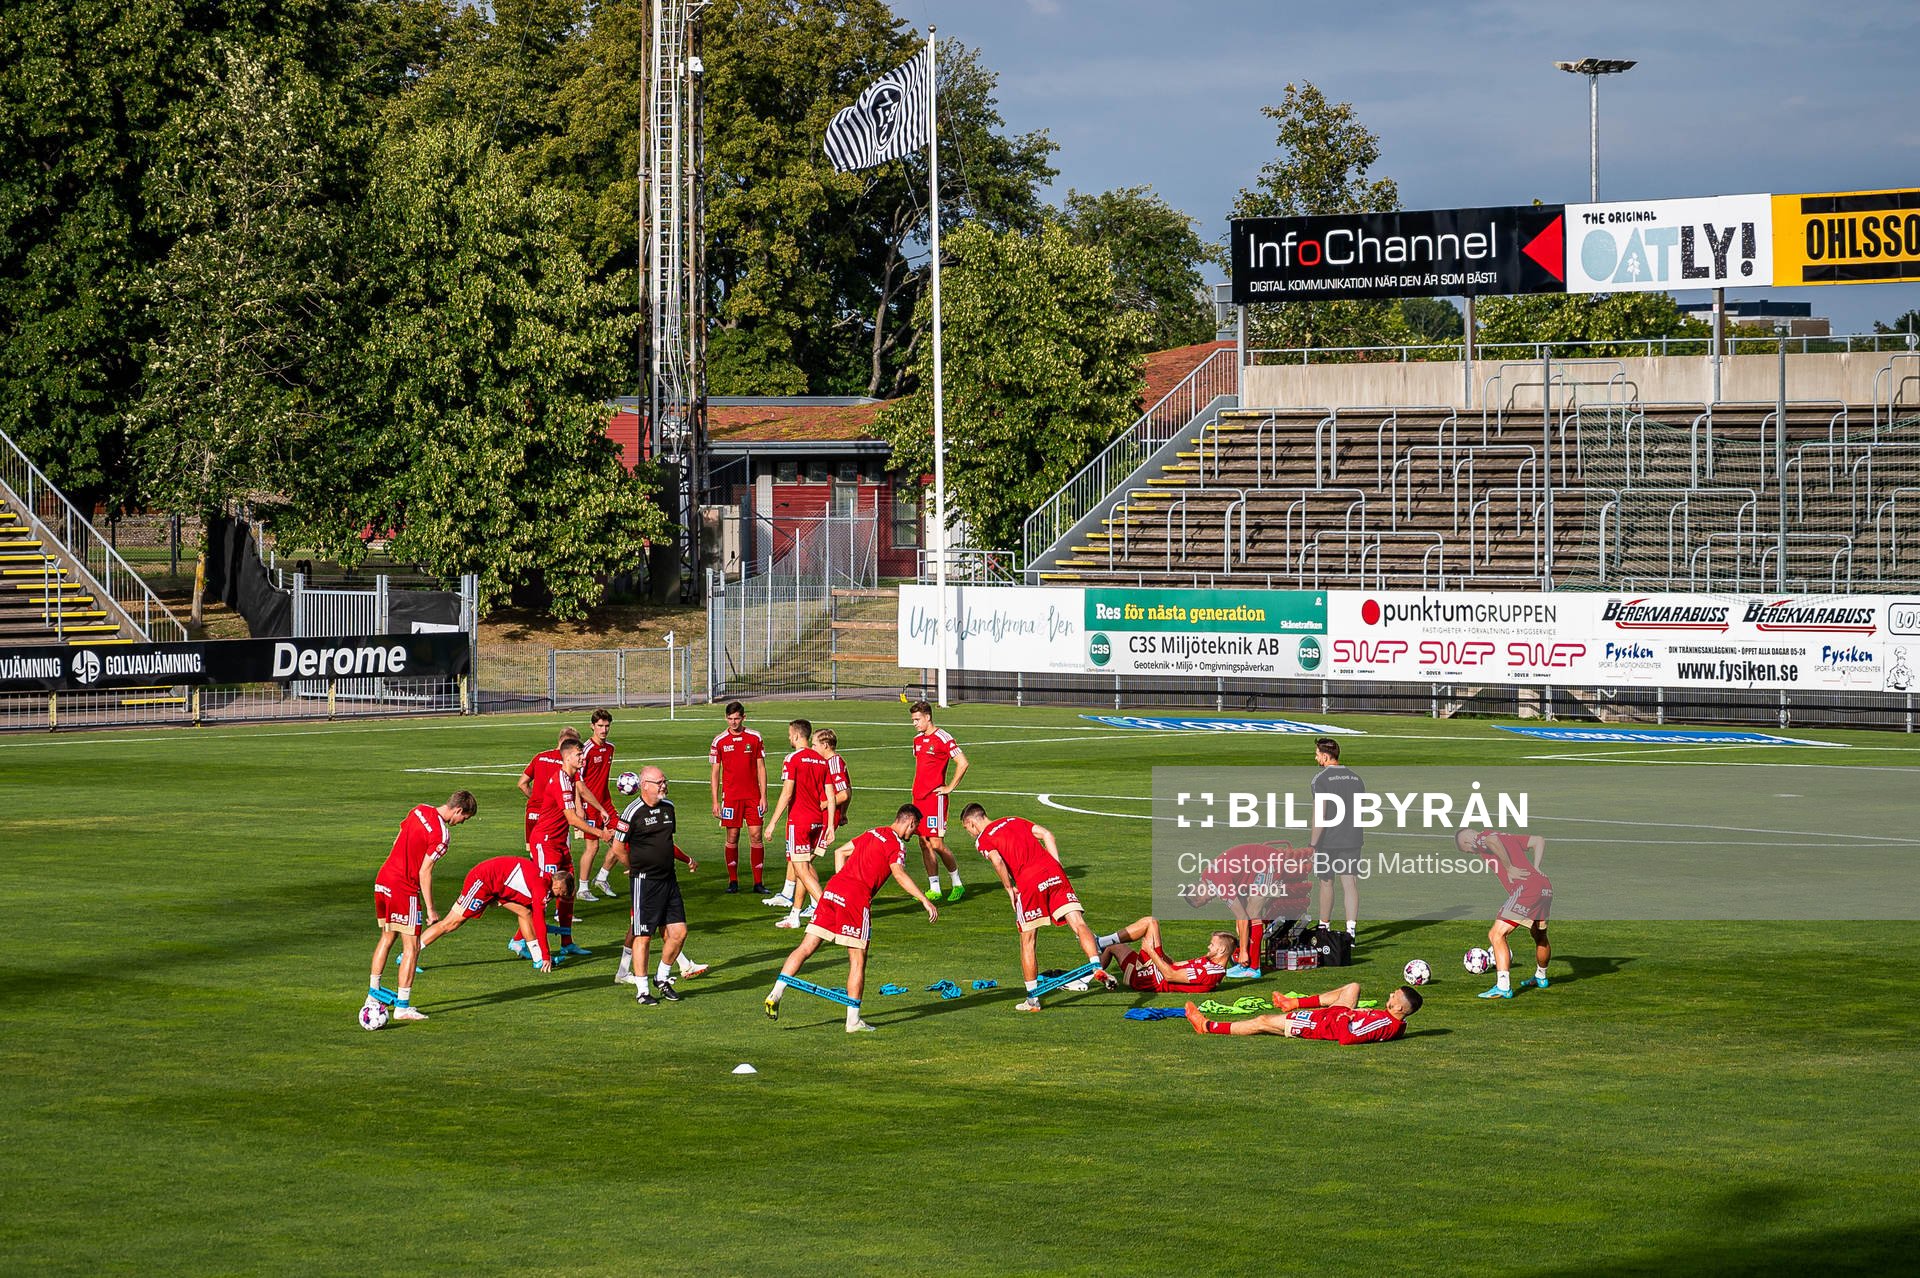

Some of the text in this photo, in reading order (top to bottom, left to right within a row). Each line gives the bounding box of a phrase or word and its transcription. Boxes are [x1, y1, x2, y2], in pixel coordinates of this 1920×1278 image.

[1582, 210, 1657, 225] THE ORIGINAL
[1249, 221, 1497, 269] InfoChannel
[1806, 213, 1920, 260] OHLSSO
[1250, 270, 1497, 294] DIGITAL KOMMUNIKATION NÄR DEN ÄR SOM BÄST!
[1095, 603, 1266, 624] Res för nästa generation
[1384, 595, 1557, 627] punktumGRUPPEN
[1602, 602, 1729, 623] BERGKVARABUSS
[1743, 602, 1876, 624] BERGKVARABUSS
[1090, 643, 1110, 655] C3S
[1129, 635, 1280, 660] C3S Miljöteknik AB
[1299, 647, 1319, 659] C3S
[1334, 640, 1409, 663] SWEP
[1419, 641, 1496, 665] SWEP
[1507, 643, 1586, 667] SWEP
[1605, 642, 1654, 662] Fysiken
[1668, 646, 1678, 654] DIN
[1758, 647, 1771, 655] ALLA
[1771, 647, 1790, 656] DAGAR
[1790, 647, 1806, 656] 05-24
[1822, 645, 1873, 666] Fysiken
[0, 655, 61, 678] VJÄMNING
[105, 651, 202, 676] GOLVAVJÄMNING
[272, 642, 405, 677] Derome
[1133, 660, 1275, 673] Geoteknik Miljö Omgivningspåverkan
[1678, 661, 1799, 682] www.fysiken.se
